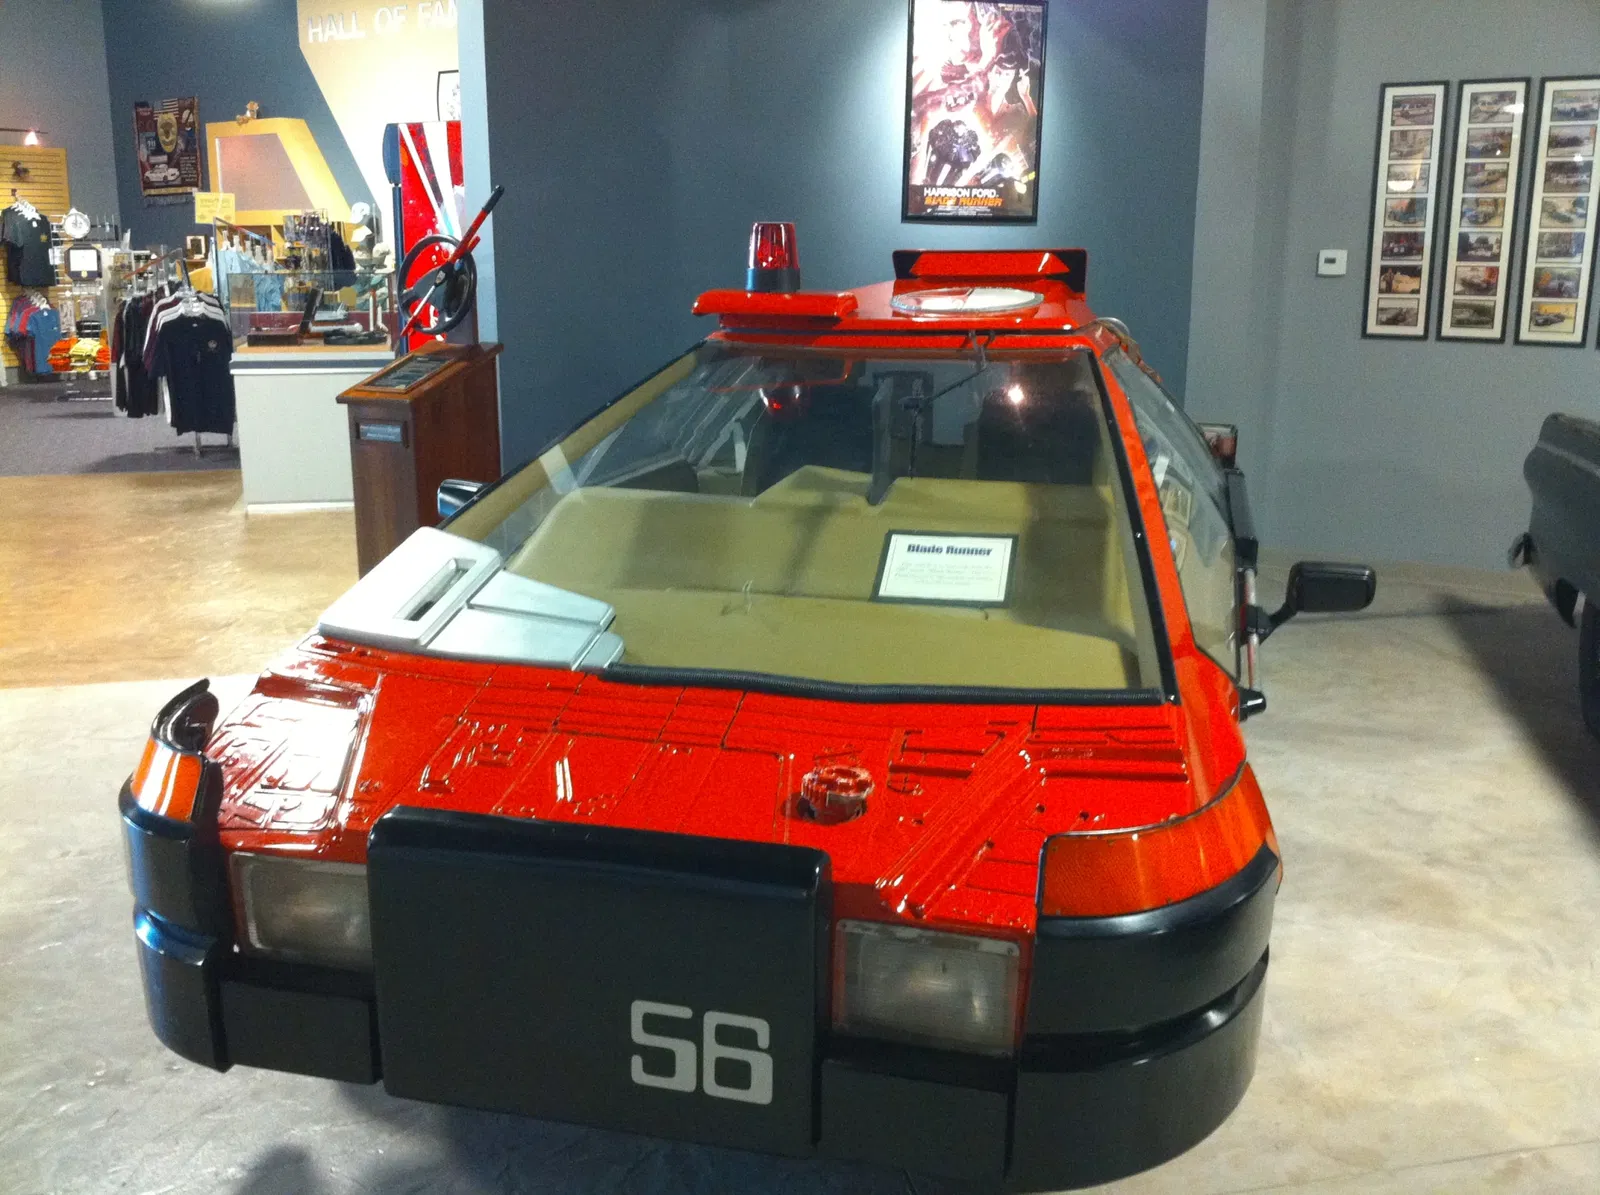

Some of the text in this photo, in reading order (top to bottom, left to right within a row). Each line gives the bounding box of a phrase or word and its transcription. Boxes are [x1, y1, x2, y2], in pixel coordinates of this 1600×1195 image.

[308, 11, 366, 43] HALL
[374, 5, 407, 35] OF
[924, 187, 969, 198] HARRISON
[959, 197, 1003, 207] RUNNER
[907, 543, 992, 556] Blade Runner
